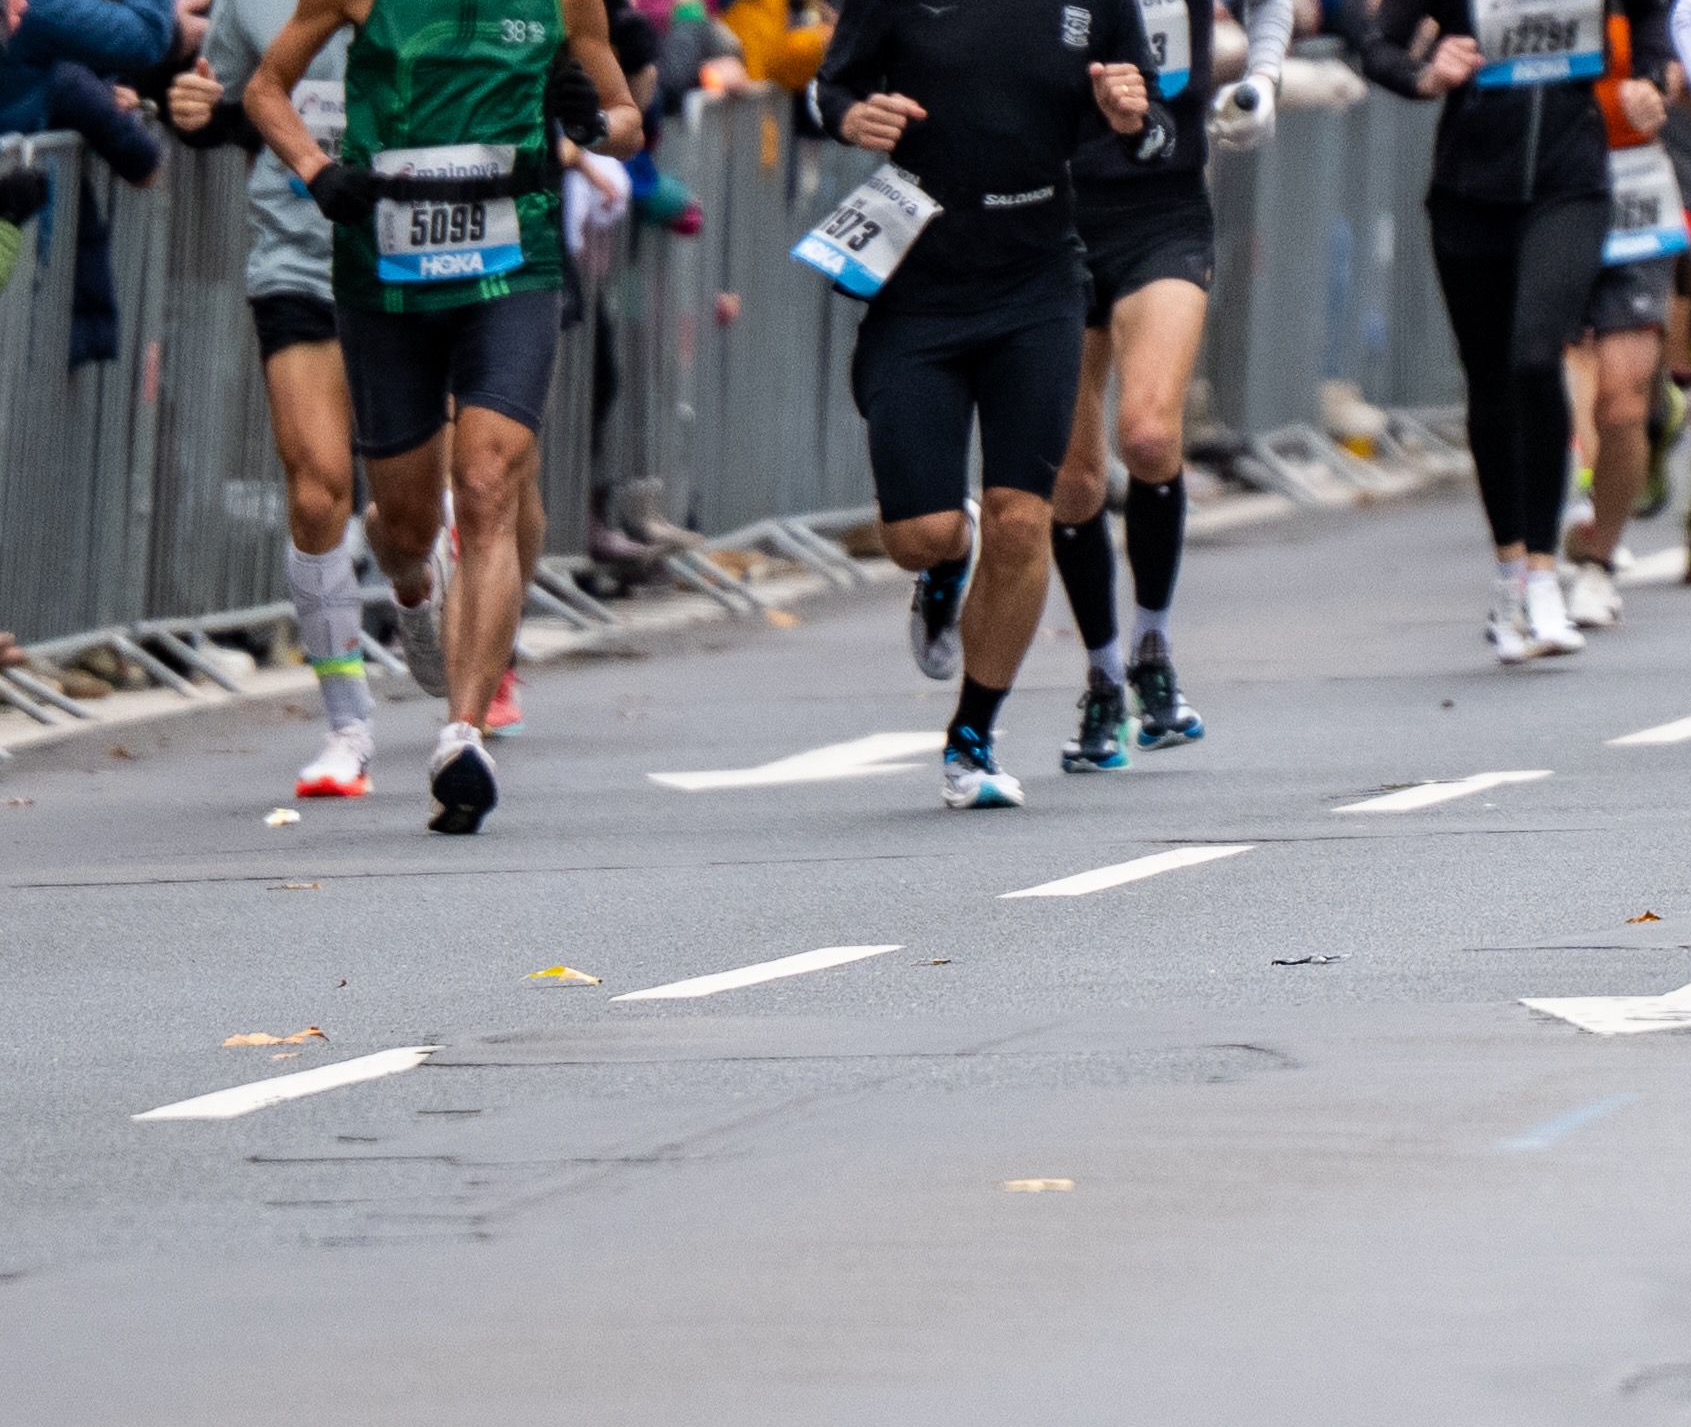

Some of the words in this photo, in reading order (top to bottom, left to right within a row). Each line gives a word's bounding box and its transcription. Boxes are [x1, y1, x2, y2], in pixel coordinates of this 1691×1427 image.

[983, 185, 1055, 207] SALOMON
[410, 203, 487, 247] 5099
[420, 252, 485, 279] HOKA
